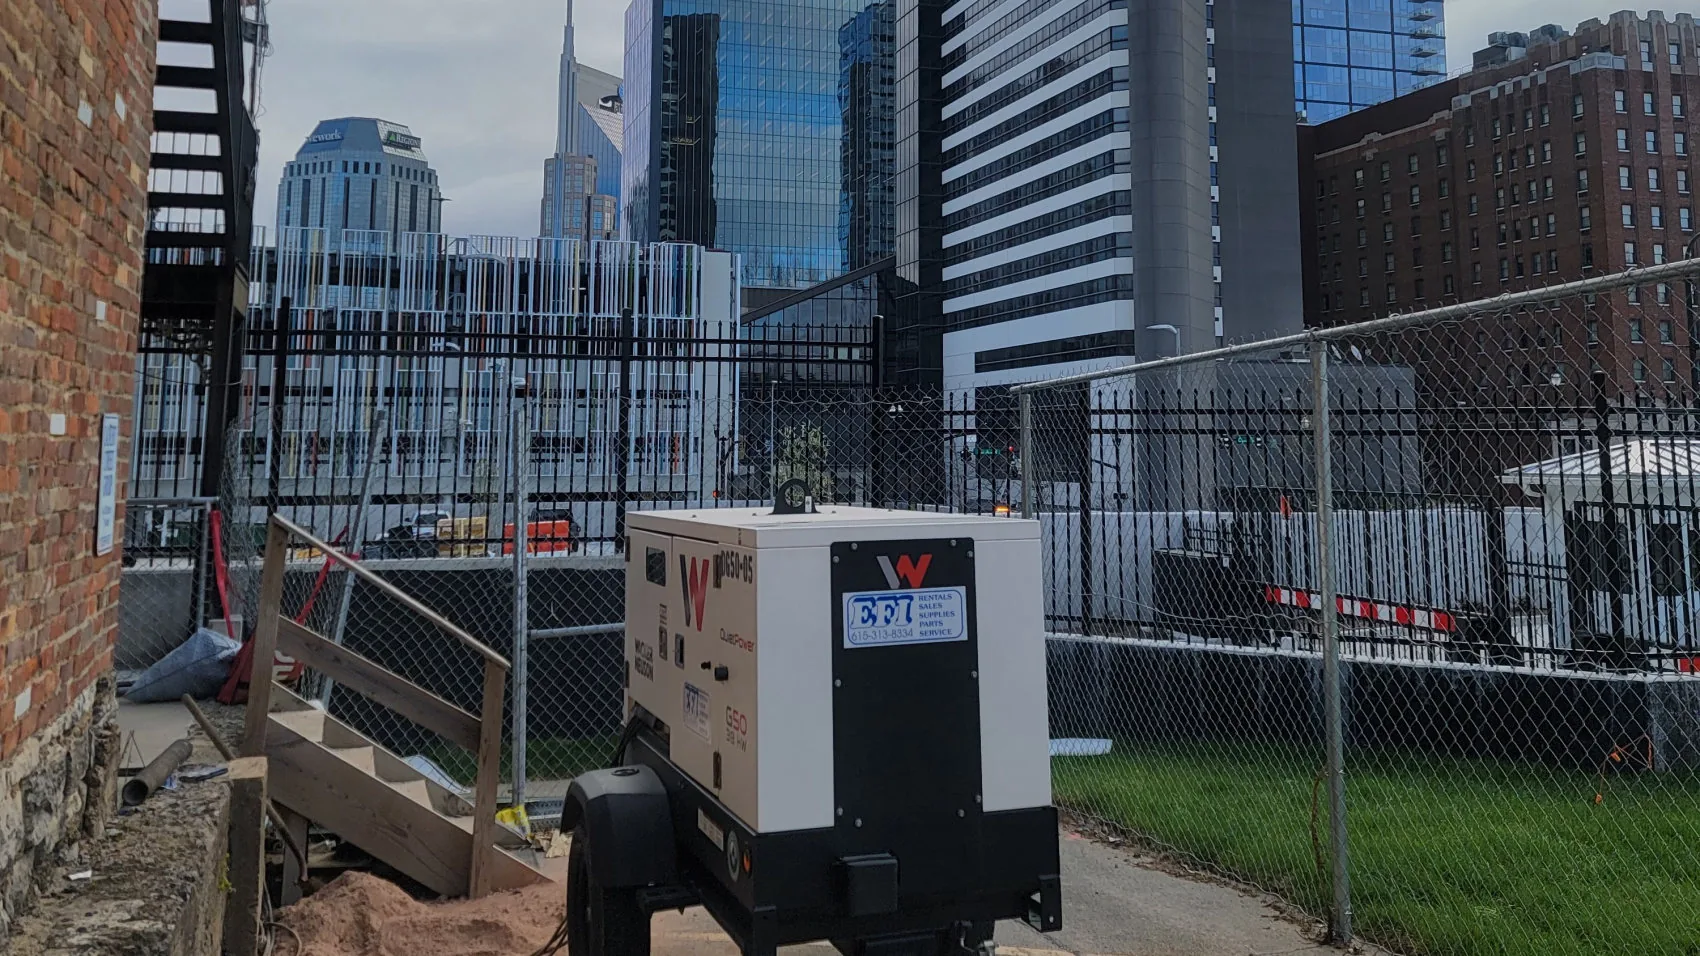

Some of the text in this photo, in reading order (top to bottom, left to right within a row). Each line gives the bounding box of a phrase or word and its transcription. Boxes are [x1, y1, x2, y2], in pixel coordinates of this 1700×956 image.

[918, 593, 953, 602] RENTALS
[918, 602, 943, 610] SALES
[850, 595, 914, 630] EFI
[918, 610, 956, 619] SUPPLIES
[919, 620, 944, 628] PARTS
[851, 628, 914, 641] 615-313-8334
[919, 628, 953, 637] SERVICE
